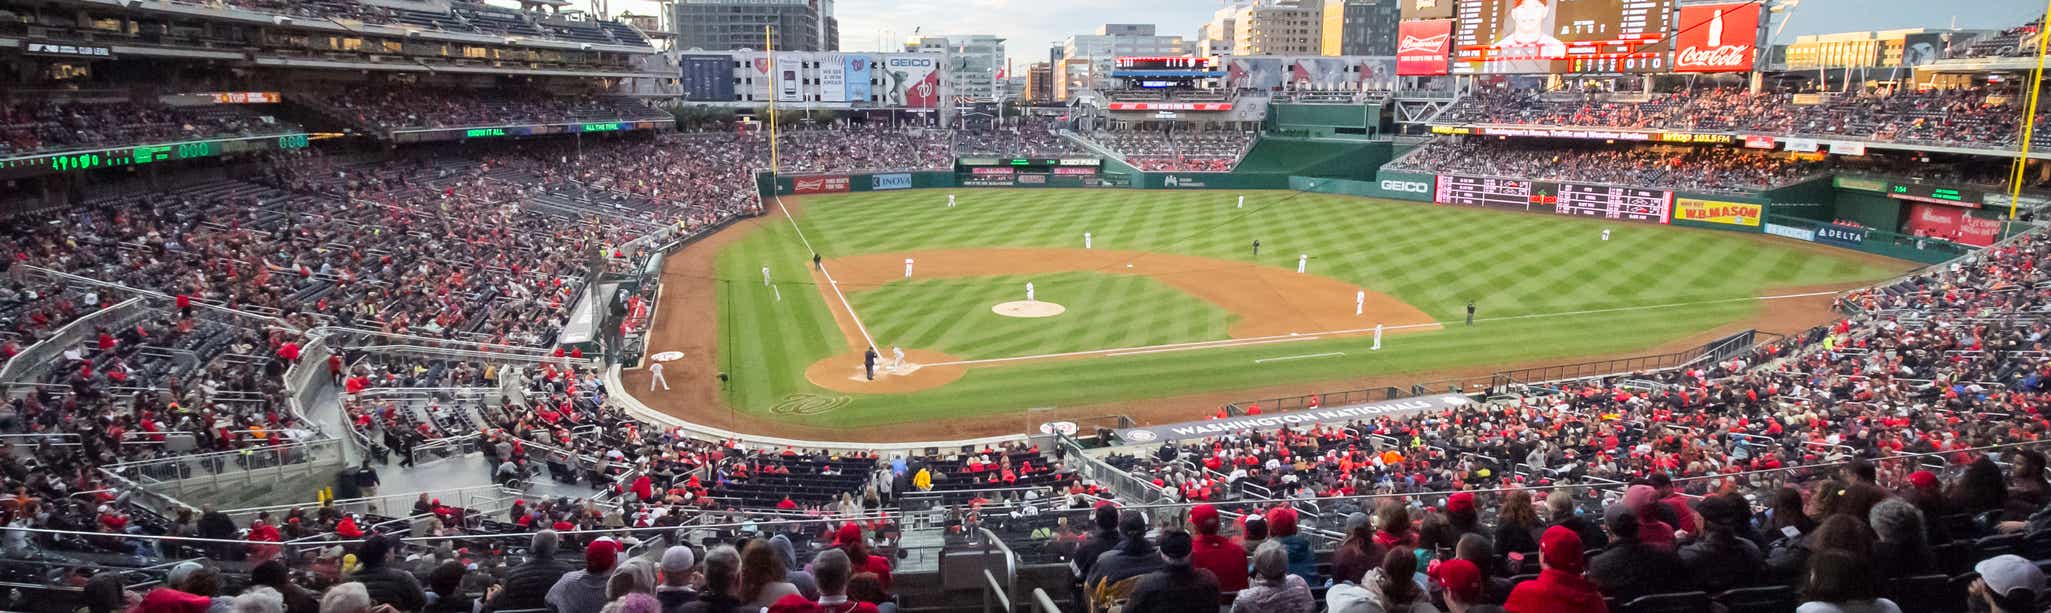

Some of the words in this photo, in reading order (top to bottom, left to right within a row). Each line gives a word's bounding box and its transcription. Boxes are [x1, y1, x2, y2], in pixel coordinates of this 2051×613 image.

[1678, 45, 1749, 66] Coca-Cola
[890, 58, 931, 67] GEICO
[1693, 134, 1717, 142] 103.5
[1717, 135, 1730, 143] FM
[882, 177, 911, 185] INOVA
[1381, 180, 1428, 193] GEICO
[1828, 229, 1862, 242] DELTA
[1171, 411, 1317, 437] WASHINGTON
[1318, 399, 1434, 420] NATIONALS
